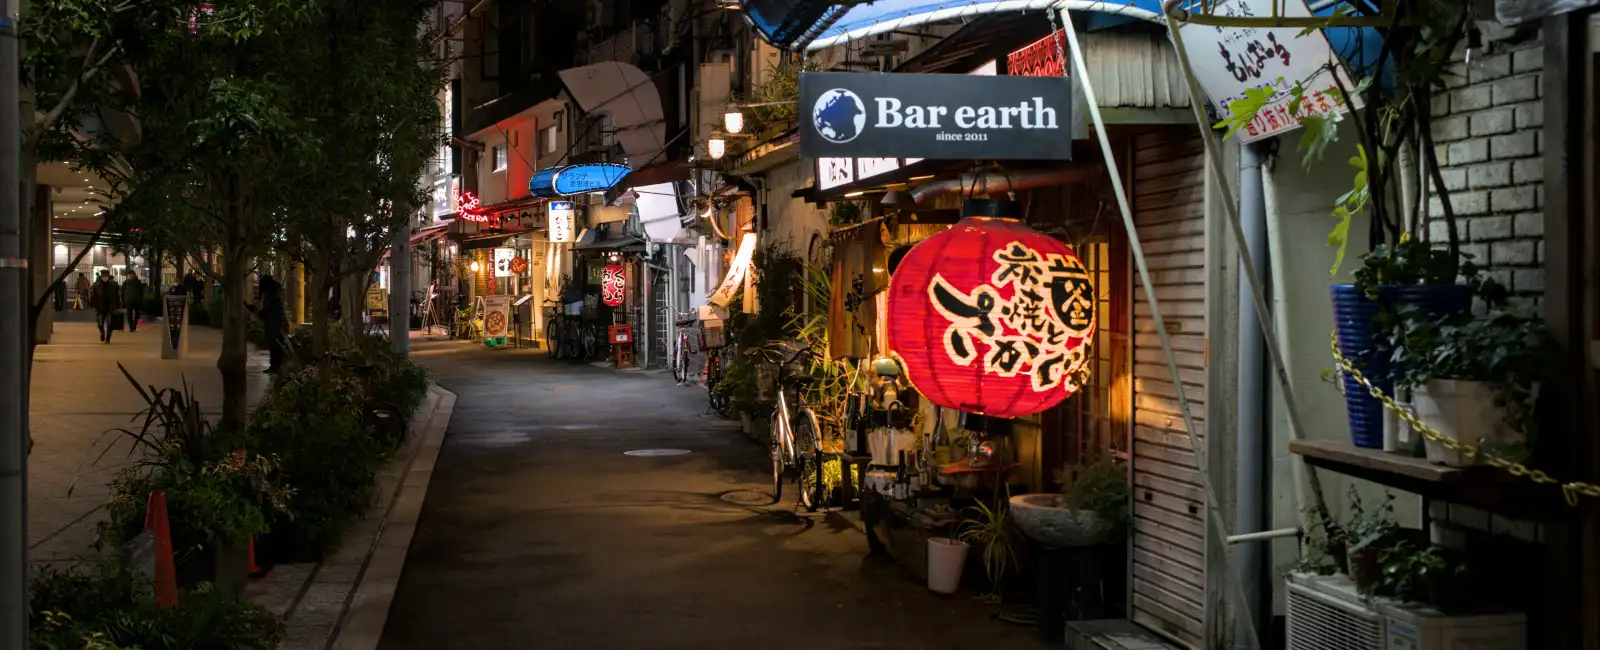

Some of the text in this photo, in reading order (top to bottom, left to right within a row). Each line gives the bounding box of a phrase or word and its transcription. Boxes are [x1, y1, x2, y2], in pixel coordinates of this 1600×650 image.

[874, 97, 1059, 129] Bar earth
[936, 131, 988, 141] since 2011
[602, 268, 613, 301] おでん
[614, 269, 625, 302] くじら
